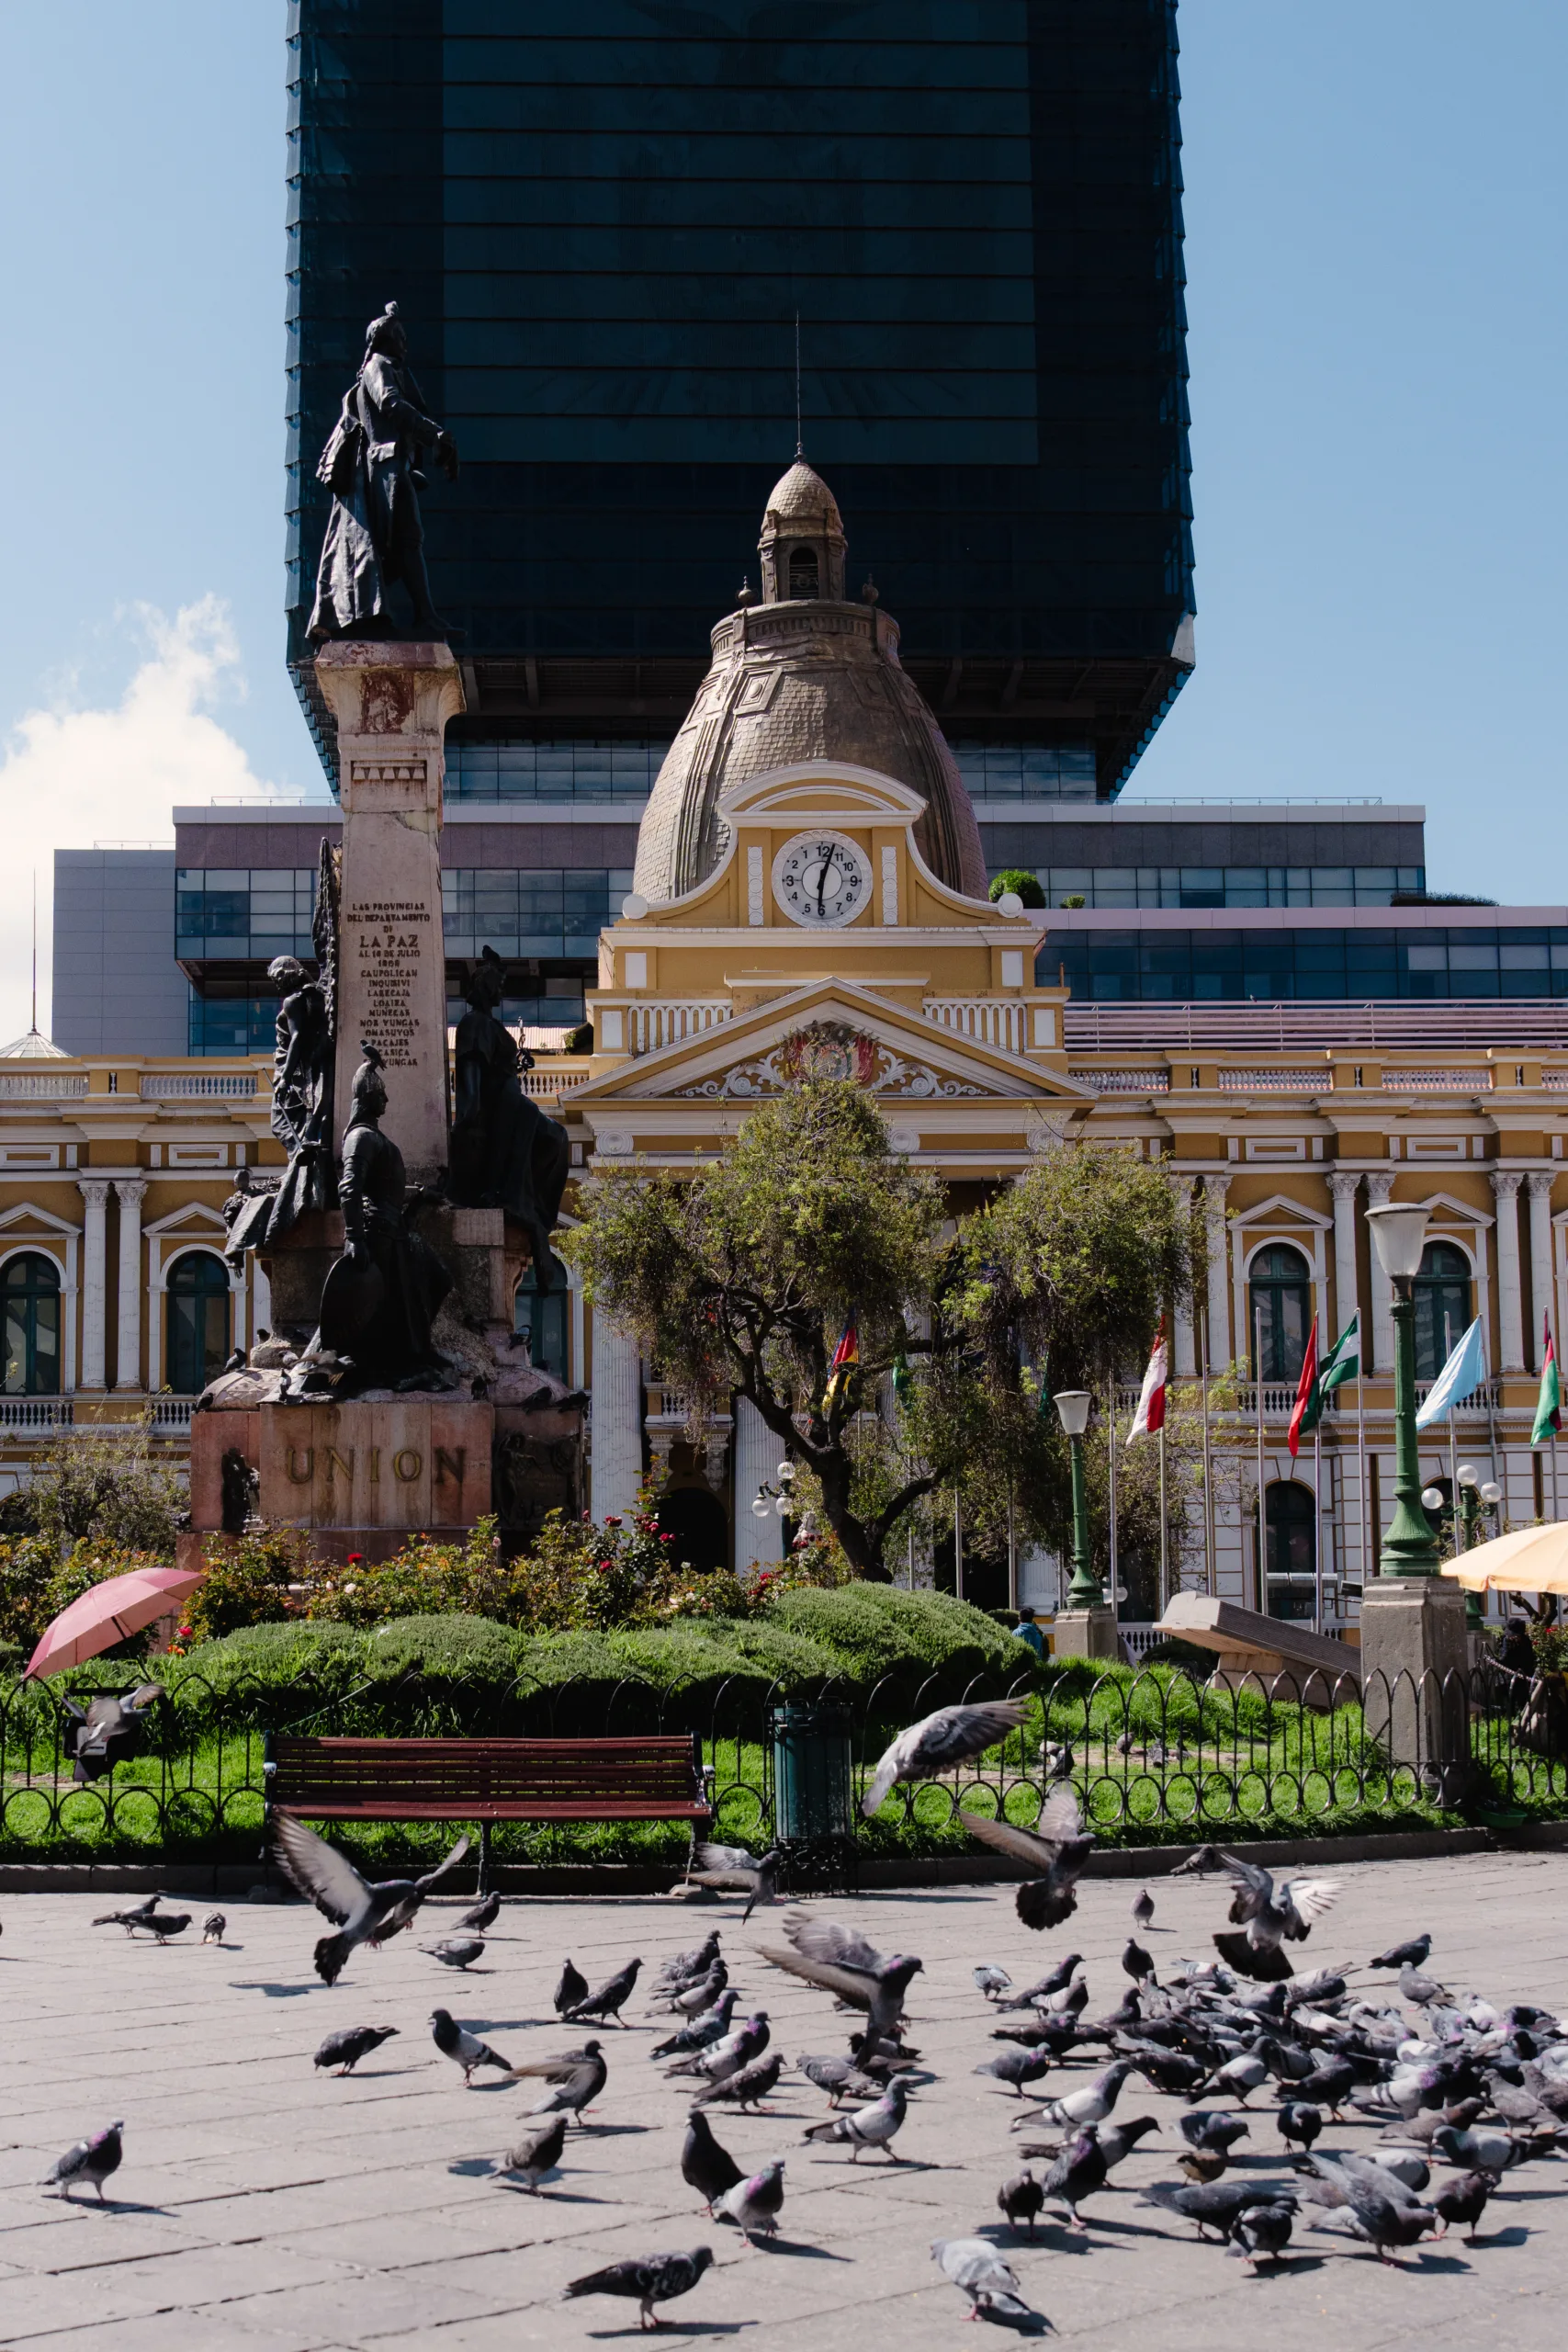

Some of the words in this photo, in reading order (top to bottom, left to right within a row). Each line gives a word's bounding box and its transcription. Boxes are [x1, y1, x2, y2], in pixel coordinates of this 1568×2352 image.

[803, 850, 807, 859] 1
[816, 845, 830, 857] 12
[834, 853, 843, 862] 11
[792, 860, 798, 869] 2
[843, 862, 853, 871] 10
[786, 875, 795, 887] 3
[850, 875, 858, 888] 9
[792, 891, 798, 900] 4
[845, 892, 852, 902] 8
[805, 903, 811, 913] 5
[818, 905, 826, 917] 6
[836, 902, 842, 911] 7
[360, 935, 381, 948] LA
[388, 934, 418, 947] PAZ
[360, 969, 417, 978] CAUPOLICAN
[369, 979, 410, 988] INQUISIVI
[360, 1019, 378, 1027] NOR
[382, 1019, 420, 1027] YUNGAS
[371, 1038, 410, 1046] PACAJES
[288, 1446, 466, 1482] UNION
